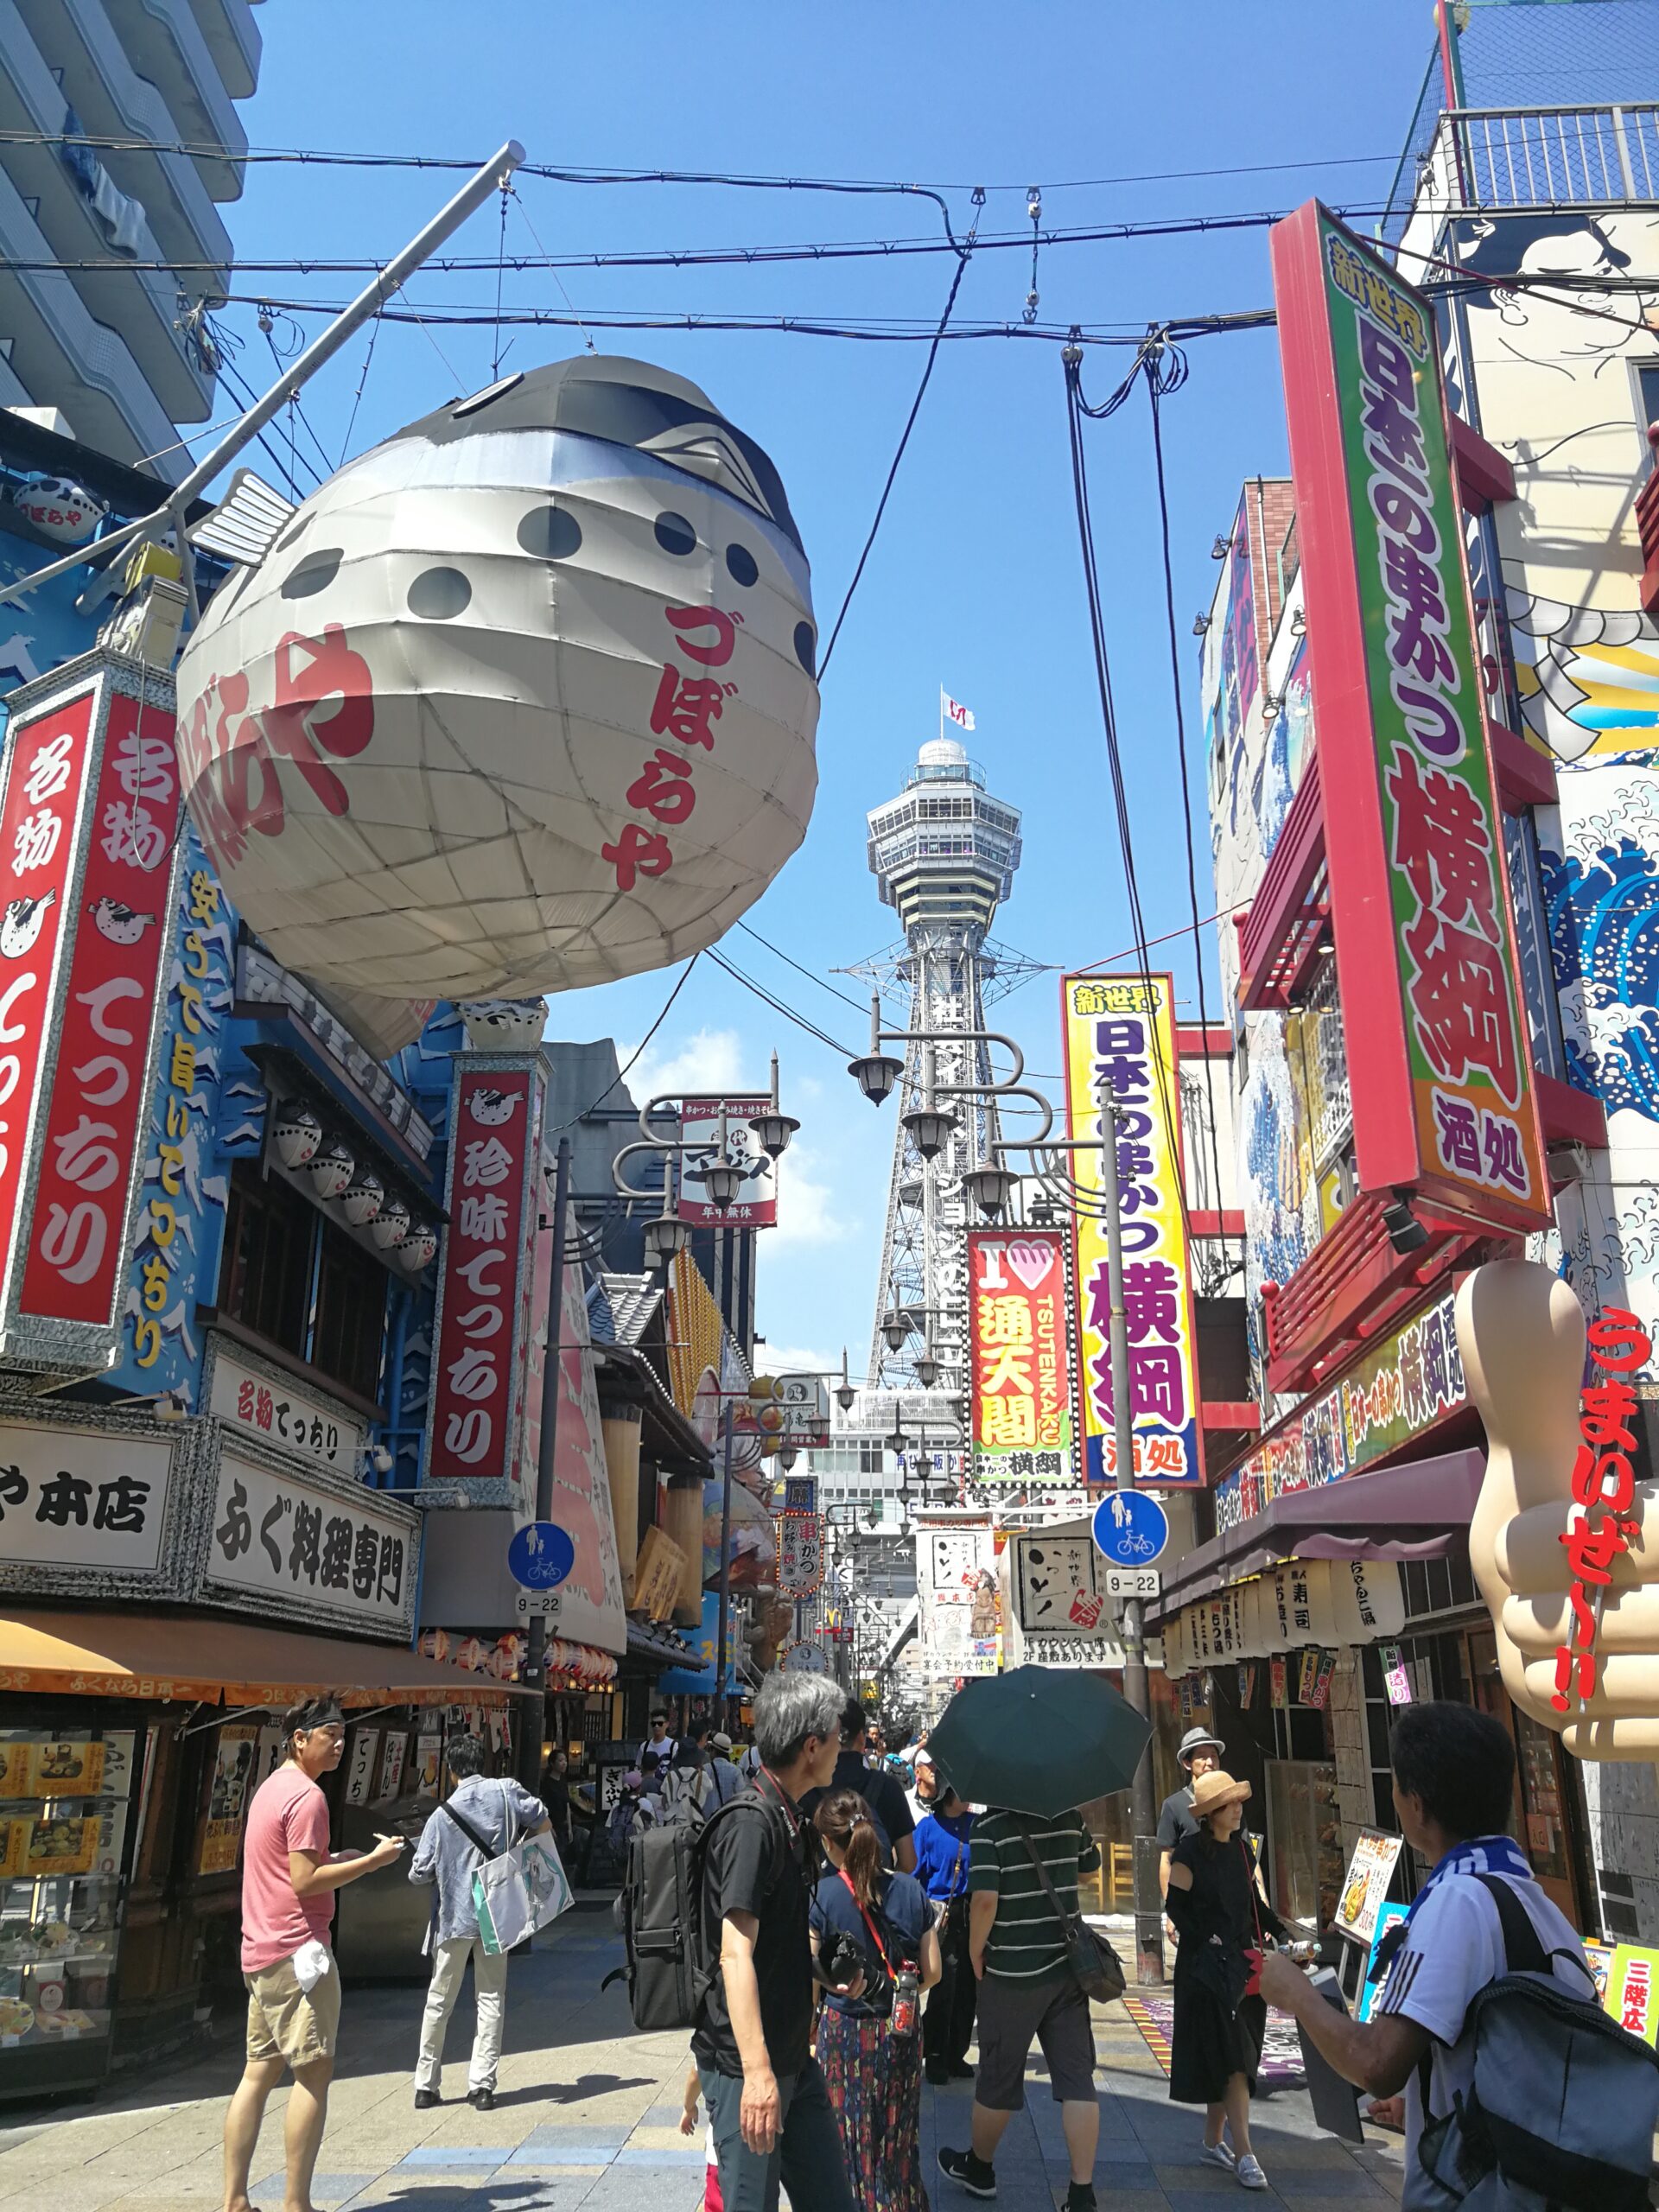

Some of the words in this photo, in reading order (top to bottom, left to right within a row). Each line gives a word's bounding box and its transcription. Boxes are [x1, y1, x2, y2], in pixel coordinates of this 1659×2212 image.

[1327, 233, 1427, 361] 新世界
[11, 733, 73, 877] 名物
[100, 731, 175, 868] 名物
[602, 604, 745, 892] づぼらや
[1387, 745, 1522, 1109] 横綱
[1074, 985, 1162, 1014] 新世界
[41, 976, 144, 1285] てっちり
[1433, 1088, 1528, 1198] 酒処
[445, 1136, 514, 1463] 珍味てっちり
[977, 1241, 1009, 1290] I
[237, 1380, 340, 1461] 名物てっちり
[978, 1294, 1036, 1447] 通天閣
[1036, 1294, 1061, 1446] TSUTENKAKU
[1007, 1451, 1064, 1477] 横綱
[1103, 1434, 1189, 1478] 酒処
[215, 1477, 404, 1607] ふぐ料理専門
[798, 1521, 818, 1573] 串かつ
[923, 1659, 995, 1671] 宴会予約受付中
[1023, 1652, 1034, 1662] 2F
[1038, 1651, 1106, 1663] 座敷あります
[1038, 1637, 1105, 1649] カウンター席
